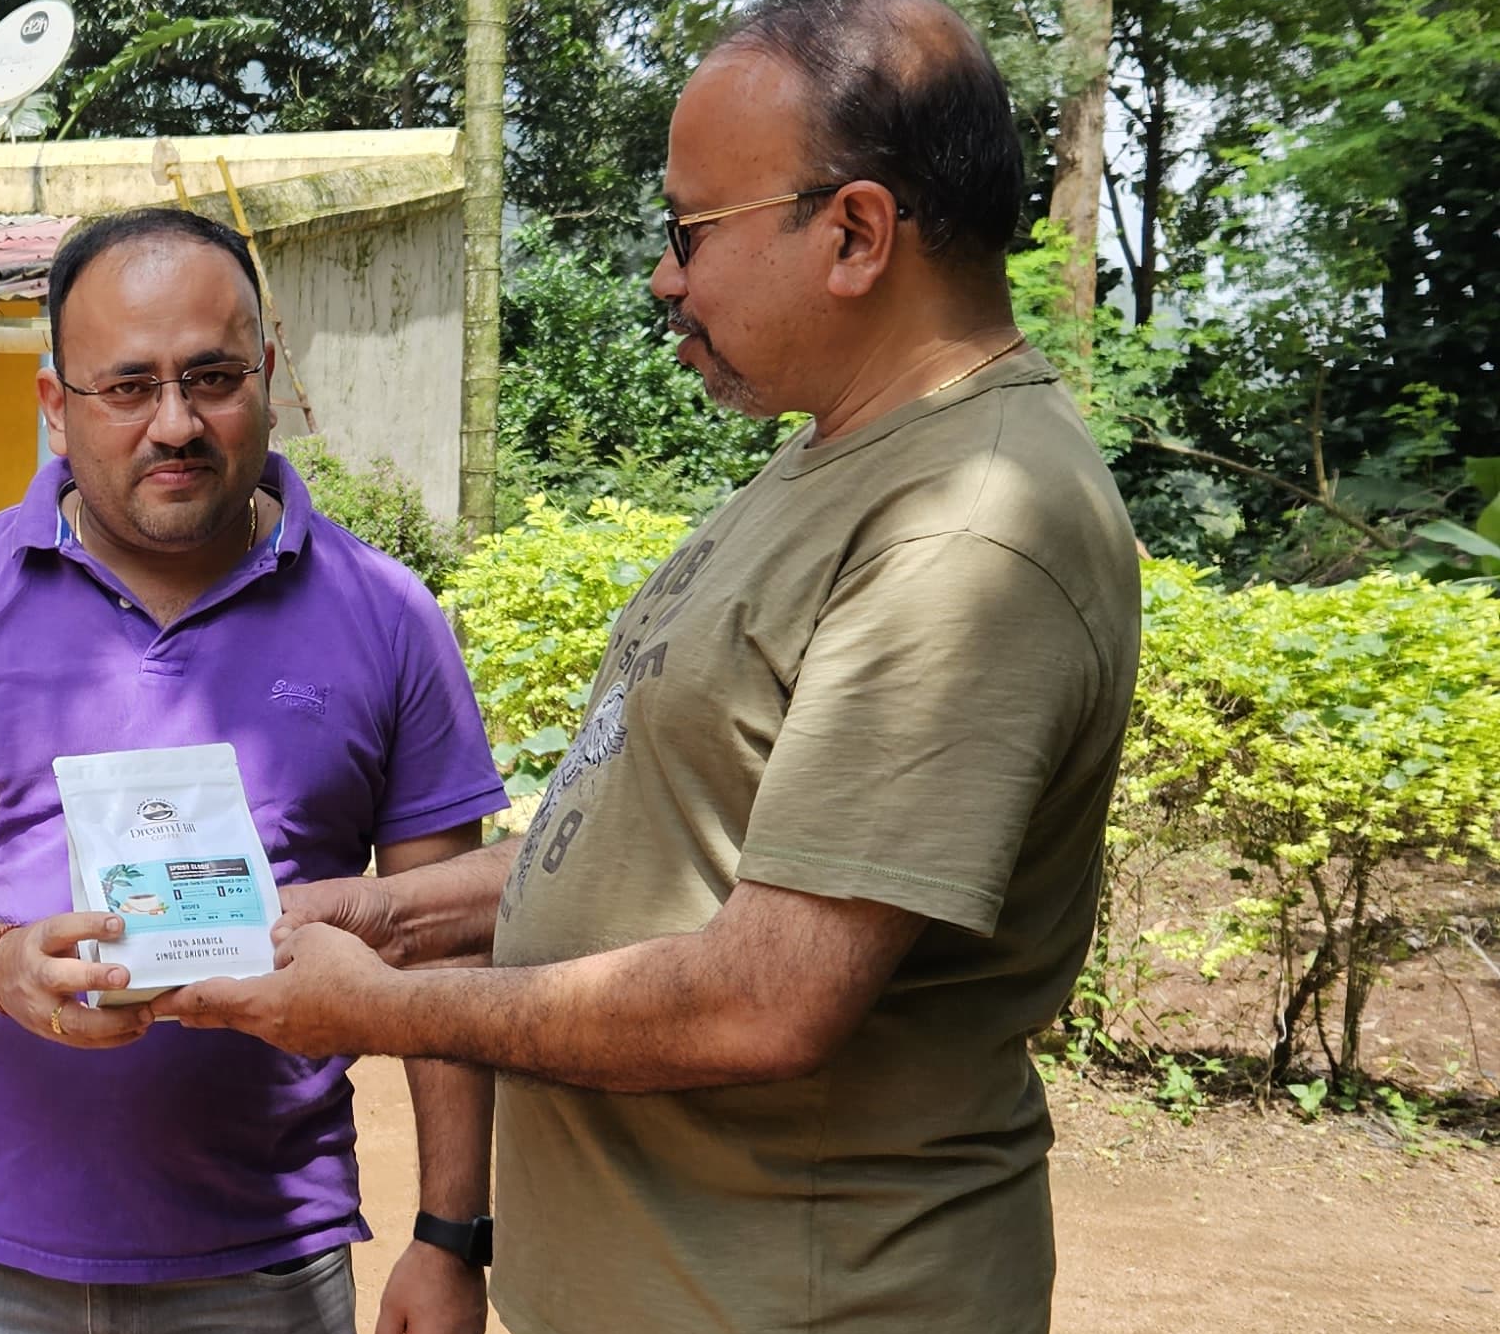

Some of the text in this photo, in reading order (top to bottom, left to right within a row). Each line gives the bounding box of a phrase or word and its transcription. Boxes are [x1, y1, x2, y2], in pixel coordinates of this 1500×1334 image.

[168, 936, 224, 948] 100% ARABICA
[155, 946, 240, 961] SINGLE ORIGIN COFFEE
